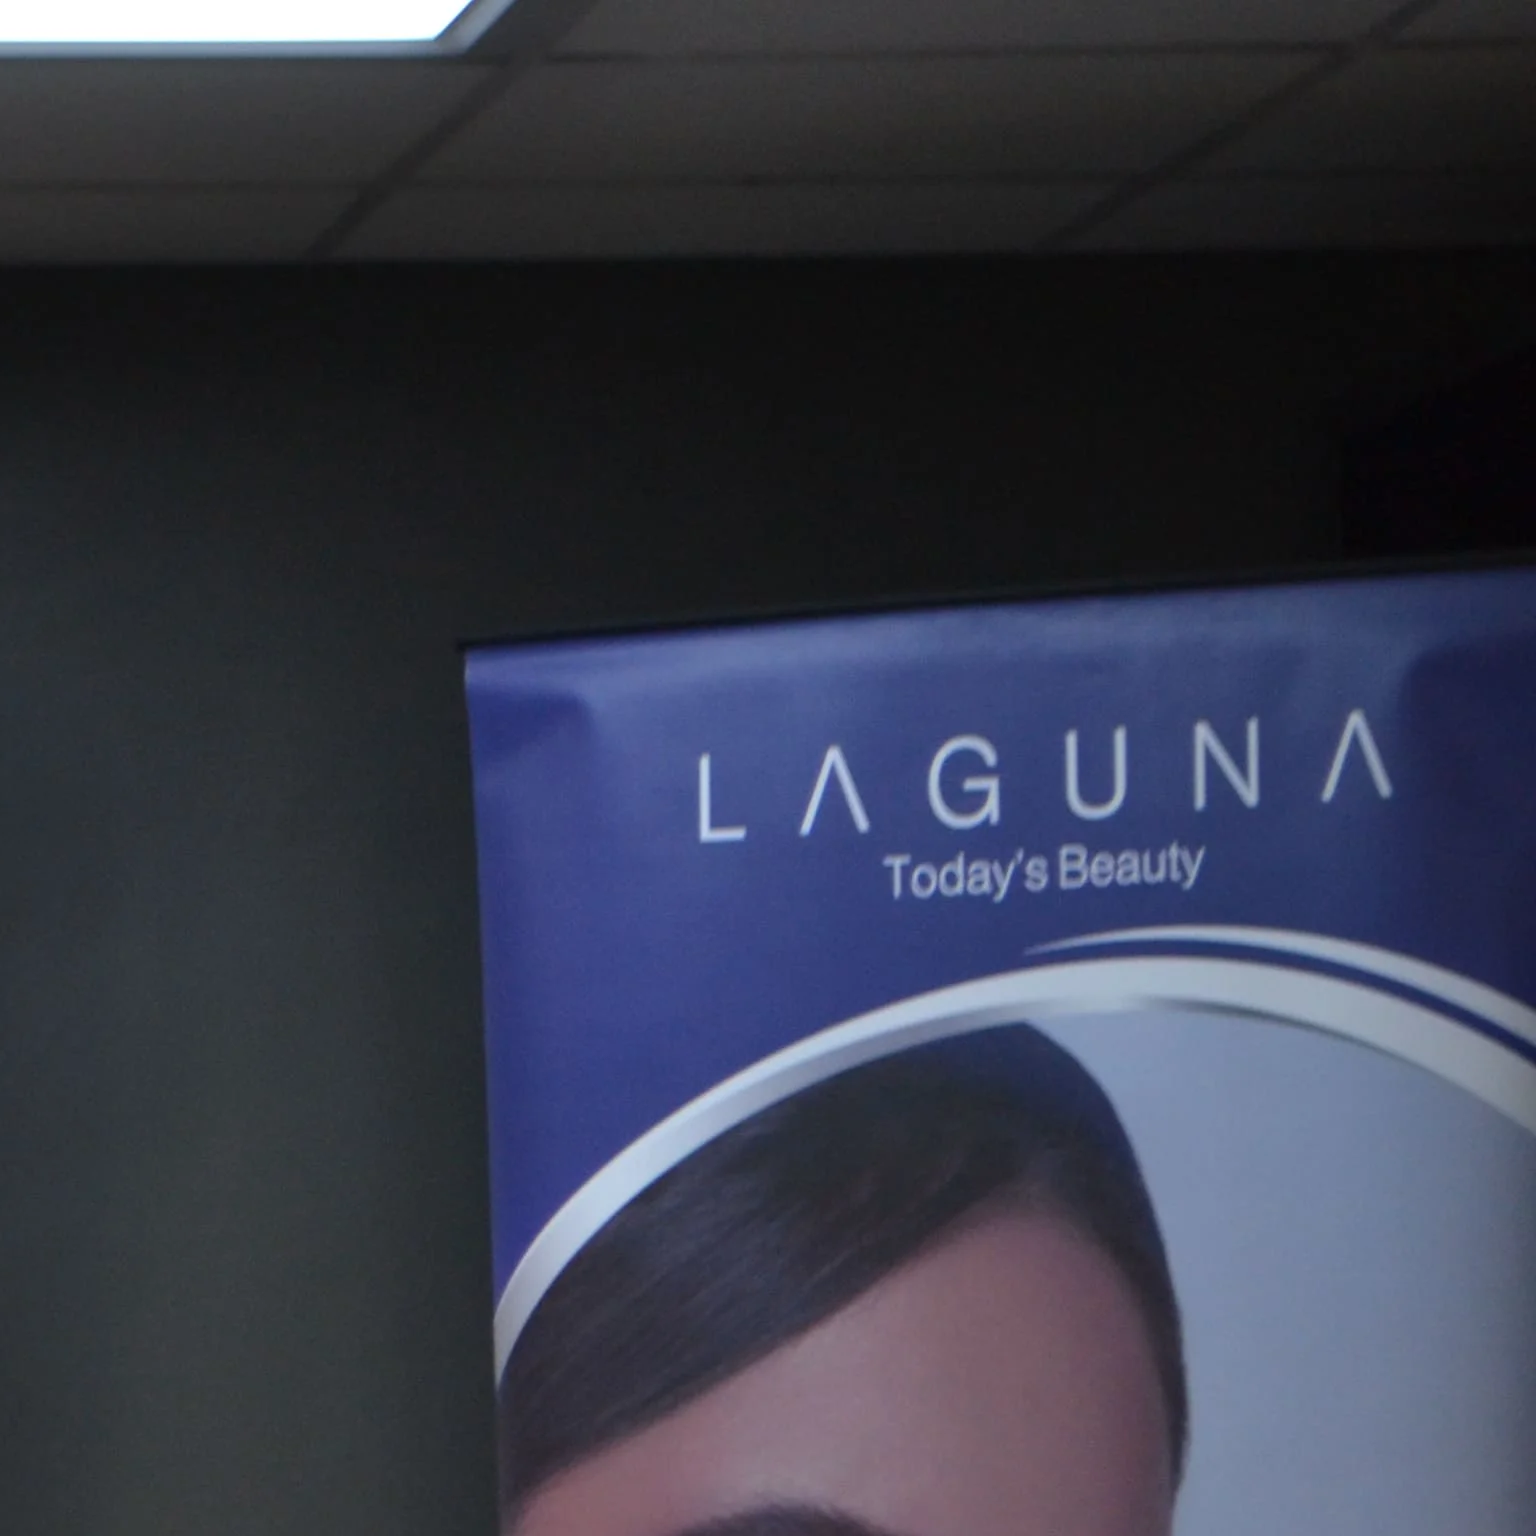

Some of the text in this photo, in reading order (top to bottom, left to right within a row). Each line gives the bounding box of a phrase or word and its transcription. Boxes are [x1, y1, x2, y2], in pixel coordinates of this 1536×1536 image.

[697, 706, 1395, 845] LAGUNA
[882, 840, 1207, 903] Today's Beauty
